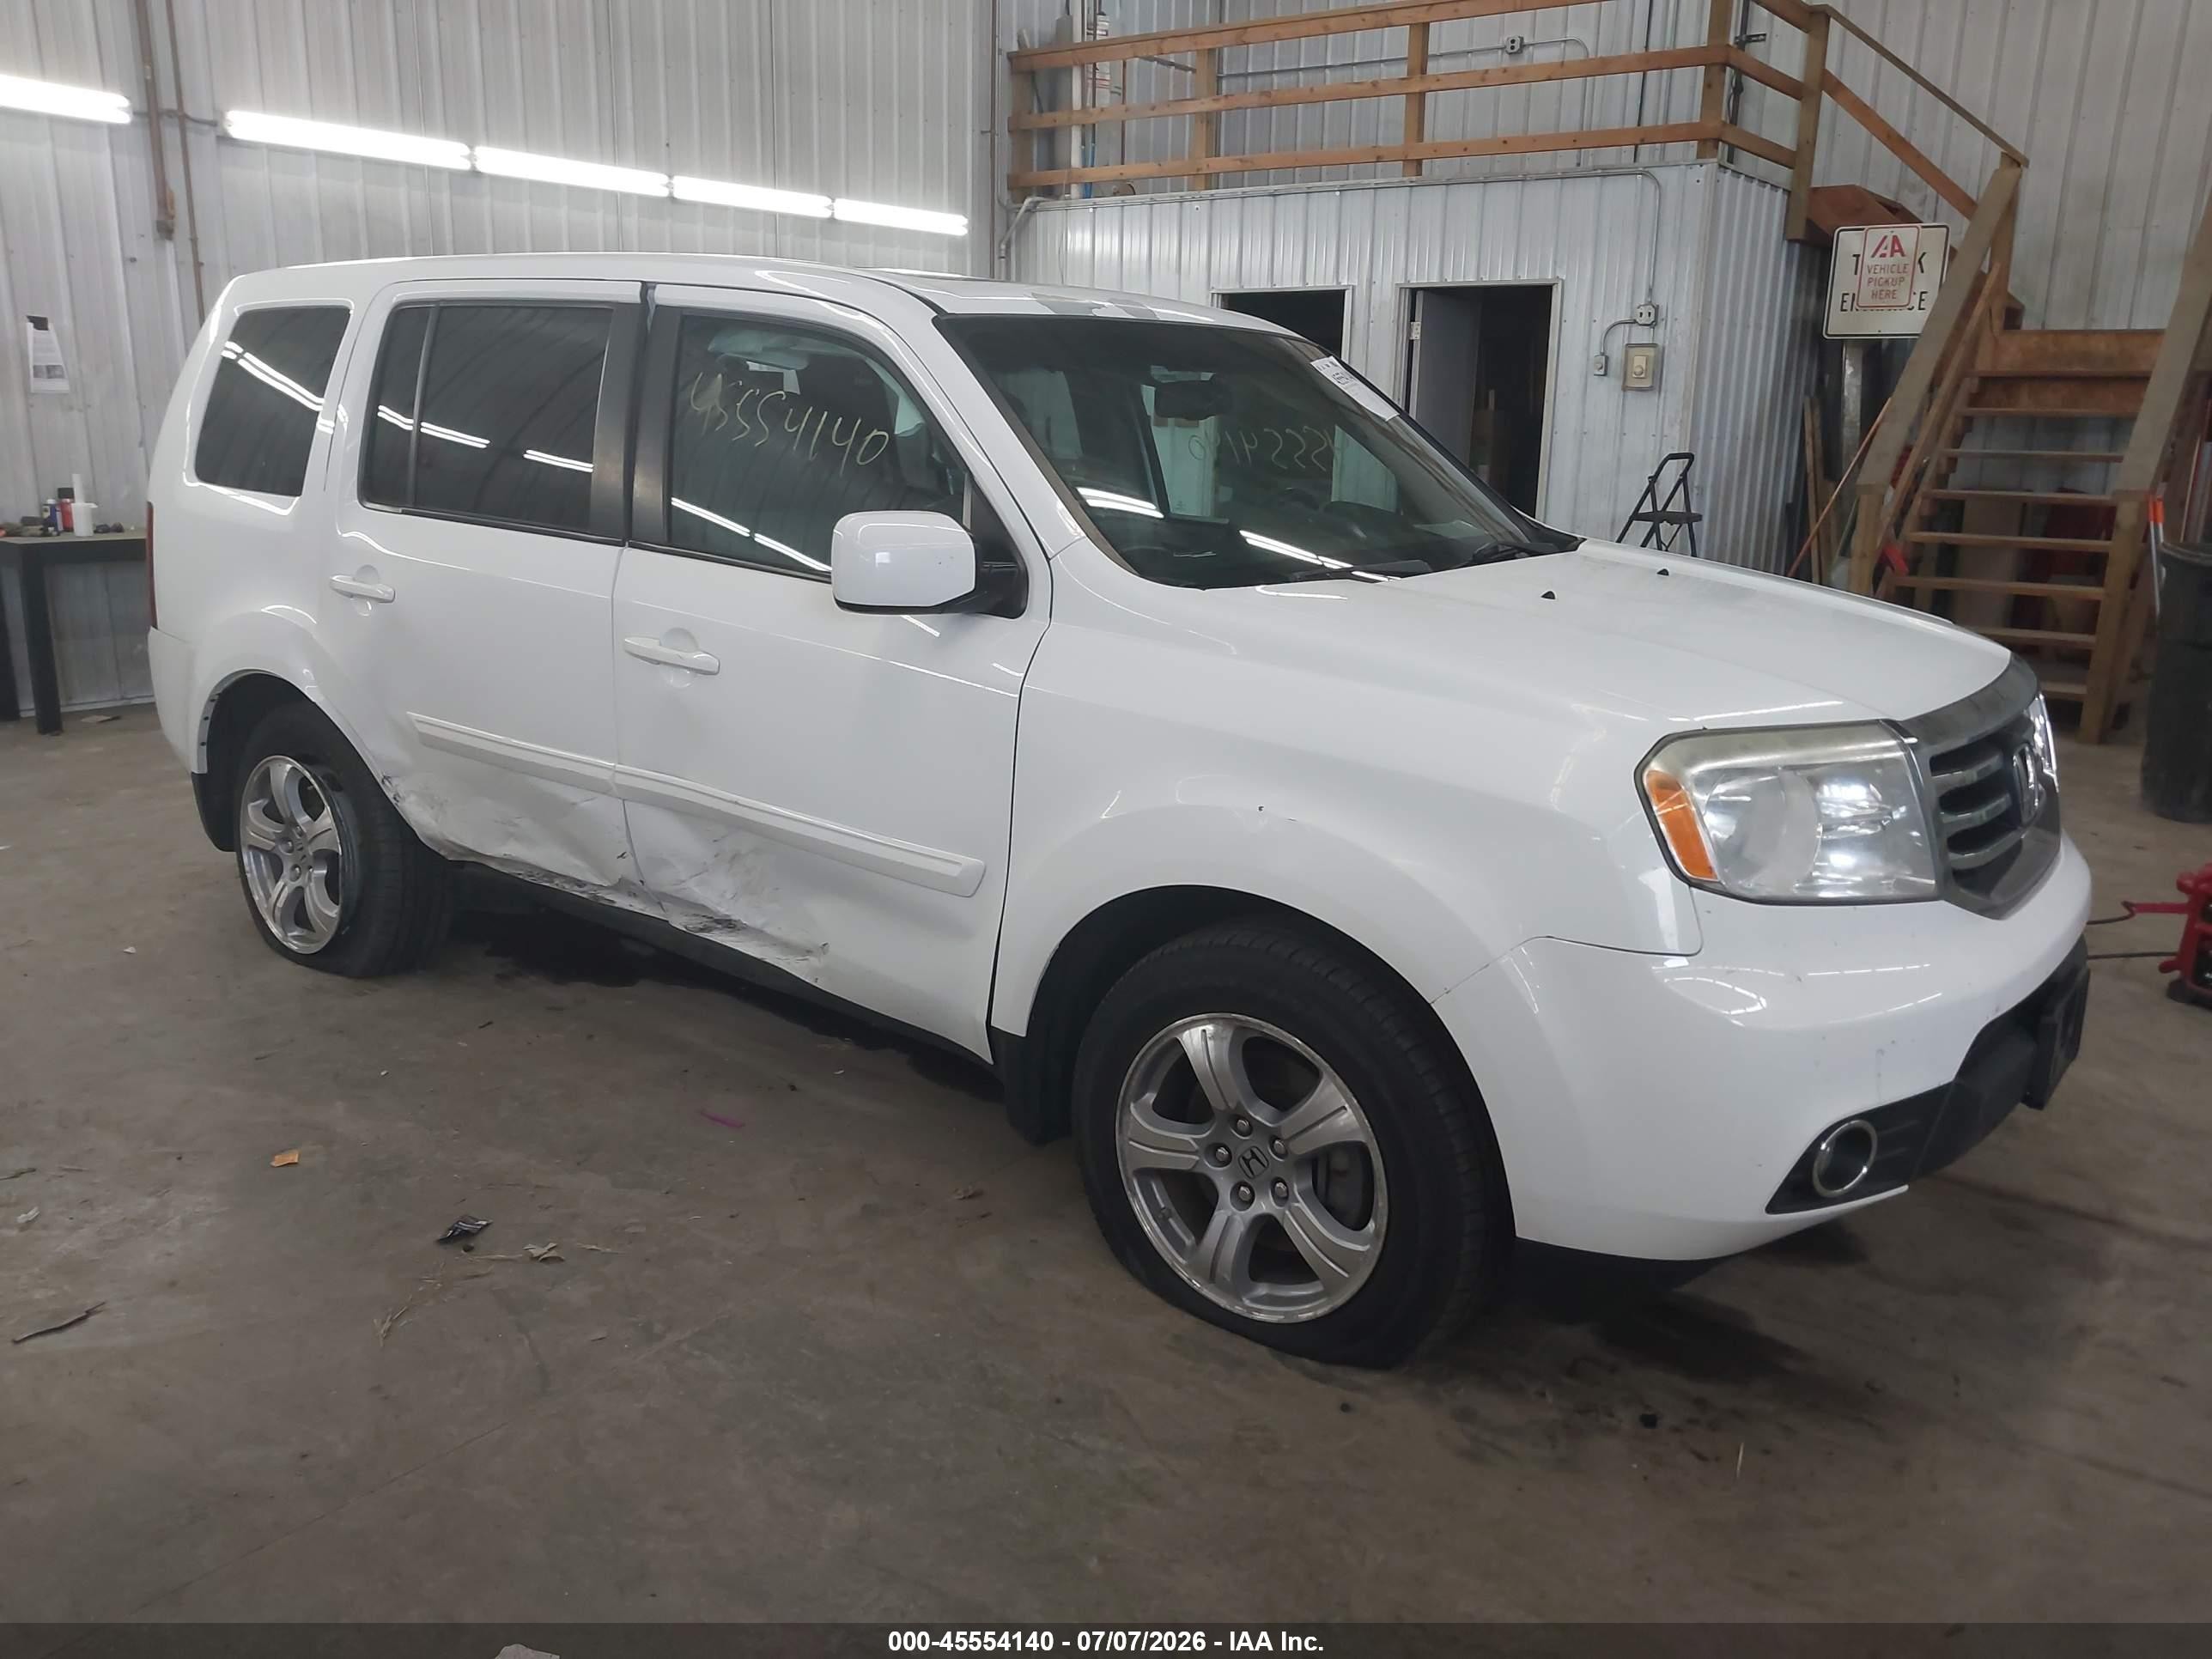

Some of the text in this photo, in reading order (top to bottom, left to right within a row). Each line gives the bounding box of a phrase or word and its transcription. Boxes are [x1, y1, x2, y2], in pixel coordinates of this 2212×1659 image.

[1867, 264, 1909, 275] VEHICLE
[1867, 276, 1905, 287] PICKUP
[1871, 289, 1897, 300] HERE
